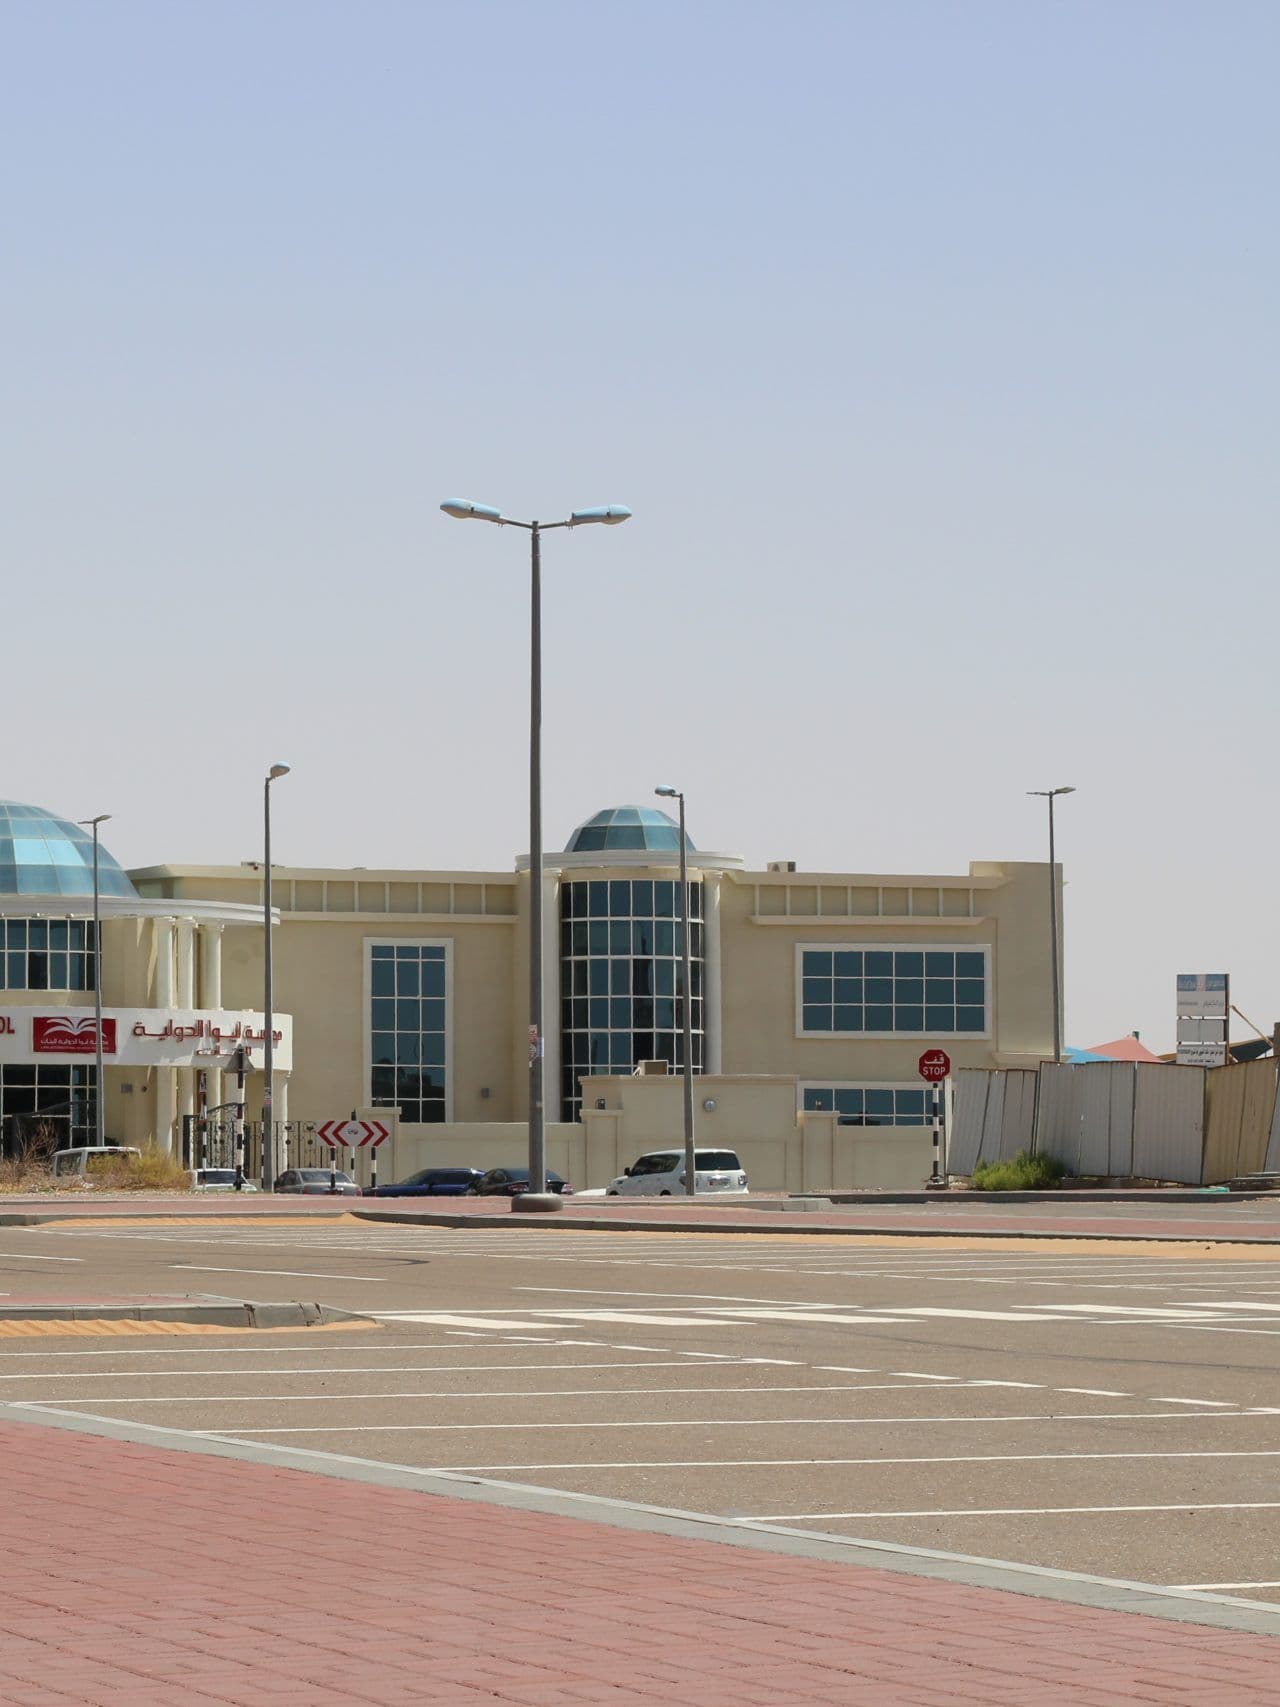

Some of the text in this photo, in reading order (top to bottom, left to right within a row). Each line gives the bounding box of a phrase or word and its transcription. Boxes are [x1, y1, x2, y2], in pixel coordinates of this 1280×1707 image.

[244, 1025, 282, 1041] مدسة
[924, 1054, 944, 1064] قف
[922, 1066, 945, 1076] STOP
